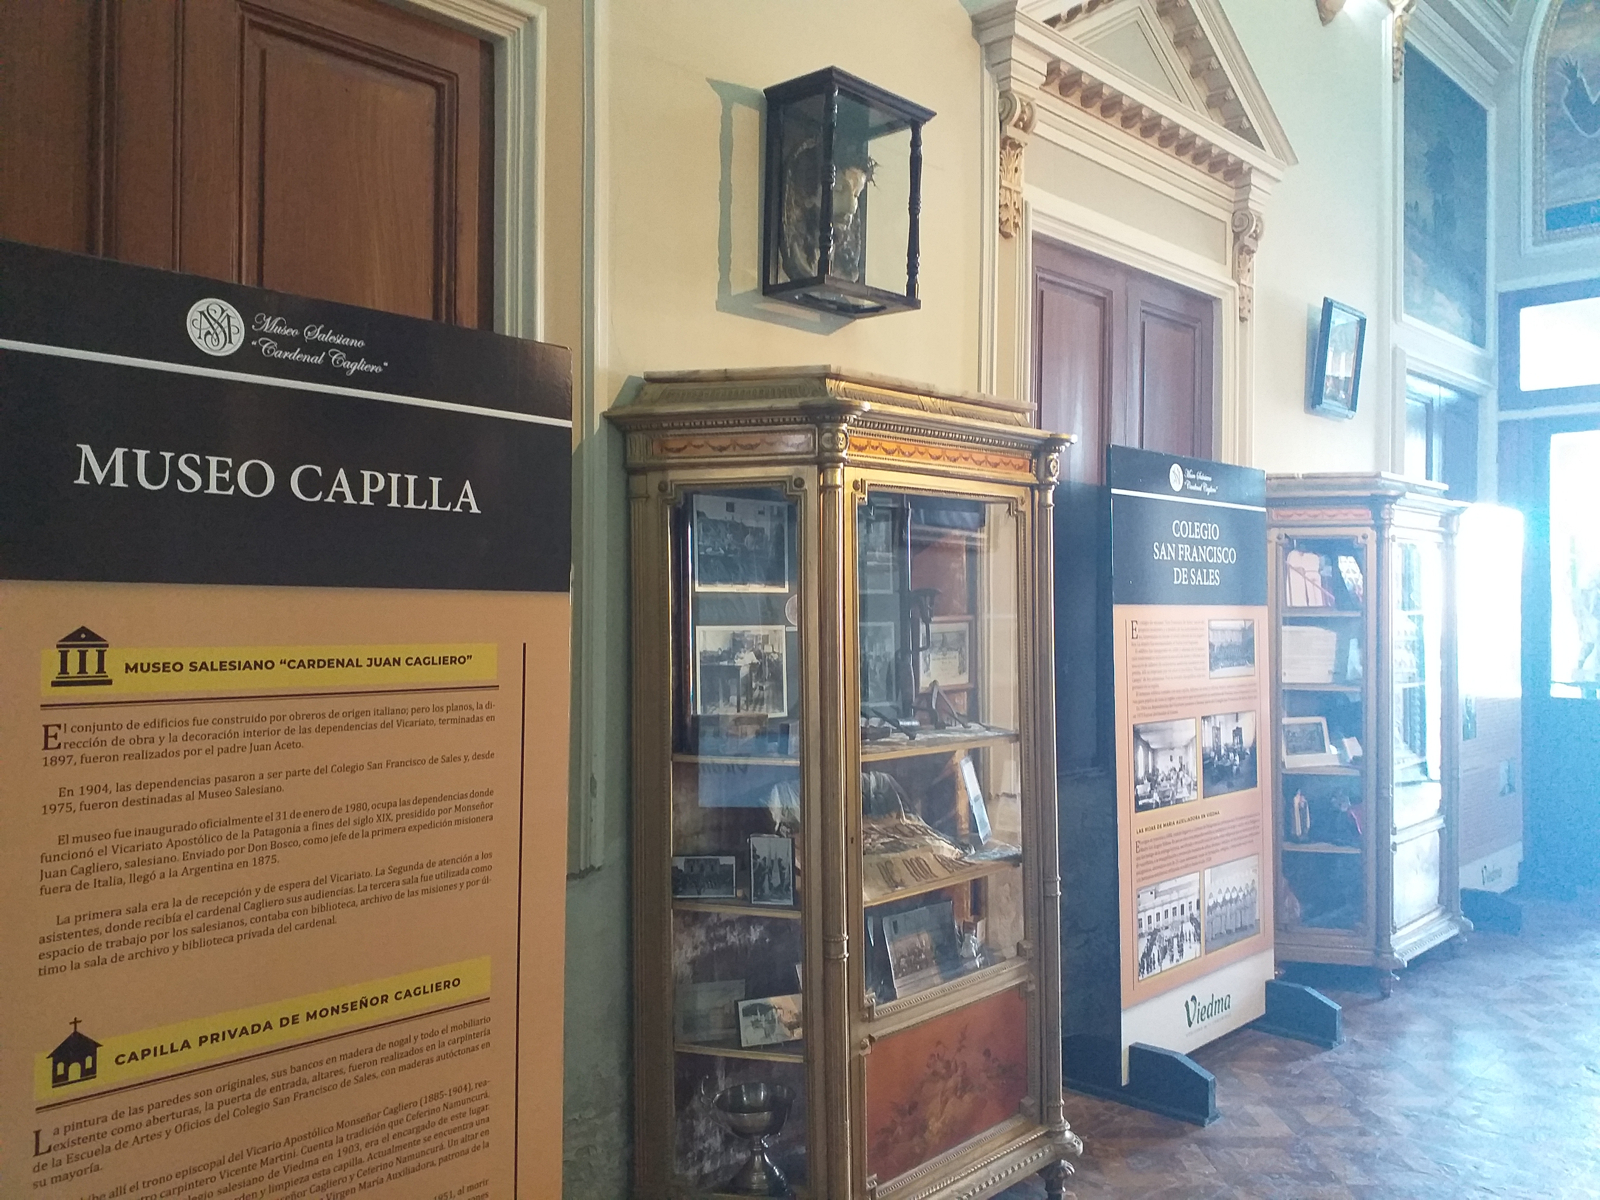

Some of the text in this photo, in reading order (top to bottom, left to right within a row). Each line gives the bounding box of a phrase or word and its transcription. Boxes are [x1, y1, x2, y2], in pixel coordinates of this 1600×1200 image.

[252, 313, 365, 348] Museo Salesiano
[74, 443, 481, 514] MUSEO CAPILLA
[1172, 520, 1220, 540] COLEGIO
[1154, 542, 1236, 564] SAN FRANCISCO
[1173, 568, 1220, 586] DE SALES
[124, 654, 472, 674] MUSEO SALESIANO “CARDENAL JUAN CAGLIERO”
[64, 714, 495, 749] rección de obra y la decoración interior de las dependencias del Vicariato, terminadas en
[70, 721, 123, 734] conjunto
[125, 719, 140, 730] de
[142, 717, 189, 729] edificios
[191, 716, 209, 726] fue
[210, 712, 267, 726] construido
[269, 713, 287, 725] por
[288, 711, 326, 721] obreros
[327, 708, 340, 719] de
[341, 708, 371, 720] origen
[373, 706, 408, 716] italiano;
[410, 705, 430, 716] pero
[431, 703, 444, 713] los
[445, 702, 474, 714] planos,
[475, 701, 483, 710] la
[484, 700, 495, 710] di-
[42, 740, 304, 767] 1897, fueron realizados por el padre Juan Aceto.
[58, 749, 495, 798] En 1904, las dependencias pasaron a ser parte del Colegio San Francisco de Sales y, desde
[41, 784, 284, 815] 1975, fueron destinadas al Museo Salesiano.
[39, 800, 494, 864] funcionó el Vicariato Apostólico de la Patagonia a fines del siglo XIX, presidido por Monseñor
[39, 853, 279, 896] fuera de Italia, llegó a la Argentina en 1875.
[37, 914, 337, 976] timo la sala de archivo y biblioteca privada del cardenal.
[114, 977, 460, 1065] CAPILLA PRIVADA DE MONSEÑOR CAGLIERO
[1184, 993, 1230, 1028] Viedma
[63, 1114, 108, 1136] pintura
[110, 1109, 125, 1121] de
[128, 1105, 144, 1117] las
[146, 1093, 191, 1114] paredes
[193, 1088, 213, 1099] son
[214, 1073, 268, 1093] originales,
[270, 1068, 287, 1079] sus
[289, 1058, 323, 1074] bancos
[325, 1055, 337, 1065] en
[339, 1046, 373, 1061] madera
[375, 1041, 386, 1052] de
[388, 1033, 411, 1048] nogal
[412, 1034, 419, 1044] y
[420, 1028, 439, 1040] todo
[440, 1023, 448, 1035] el
[450, 1015, 491, 1033] mobiliario
[31, 1161, 104, 1190] su mayoría.
[308, 1128, 490, 1194] Cagliero y Ceferino Namuncurá. Un altar en
